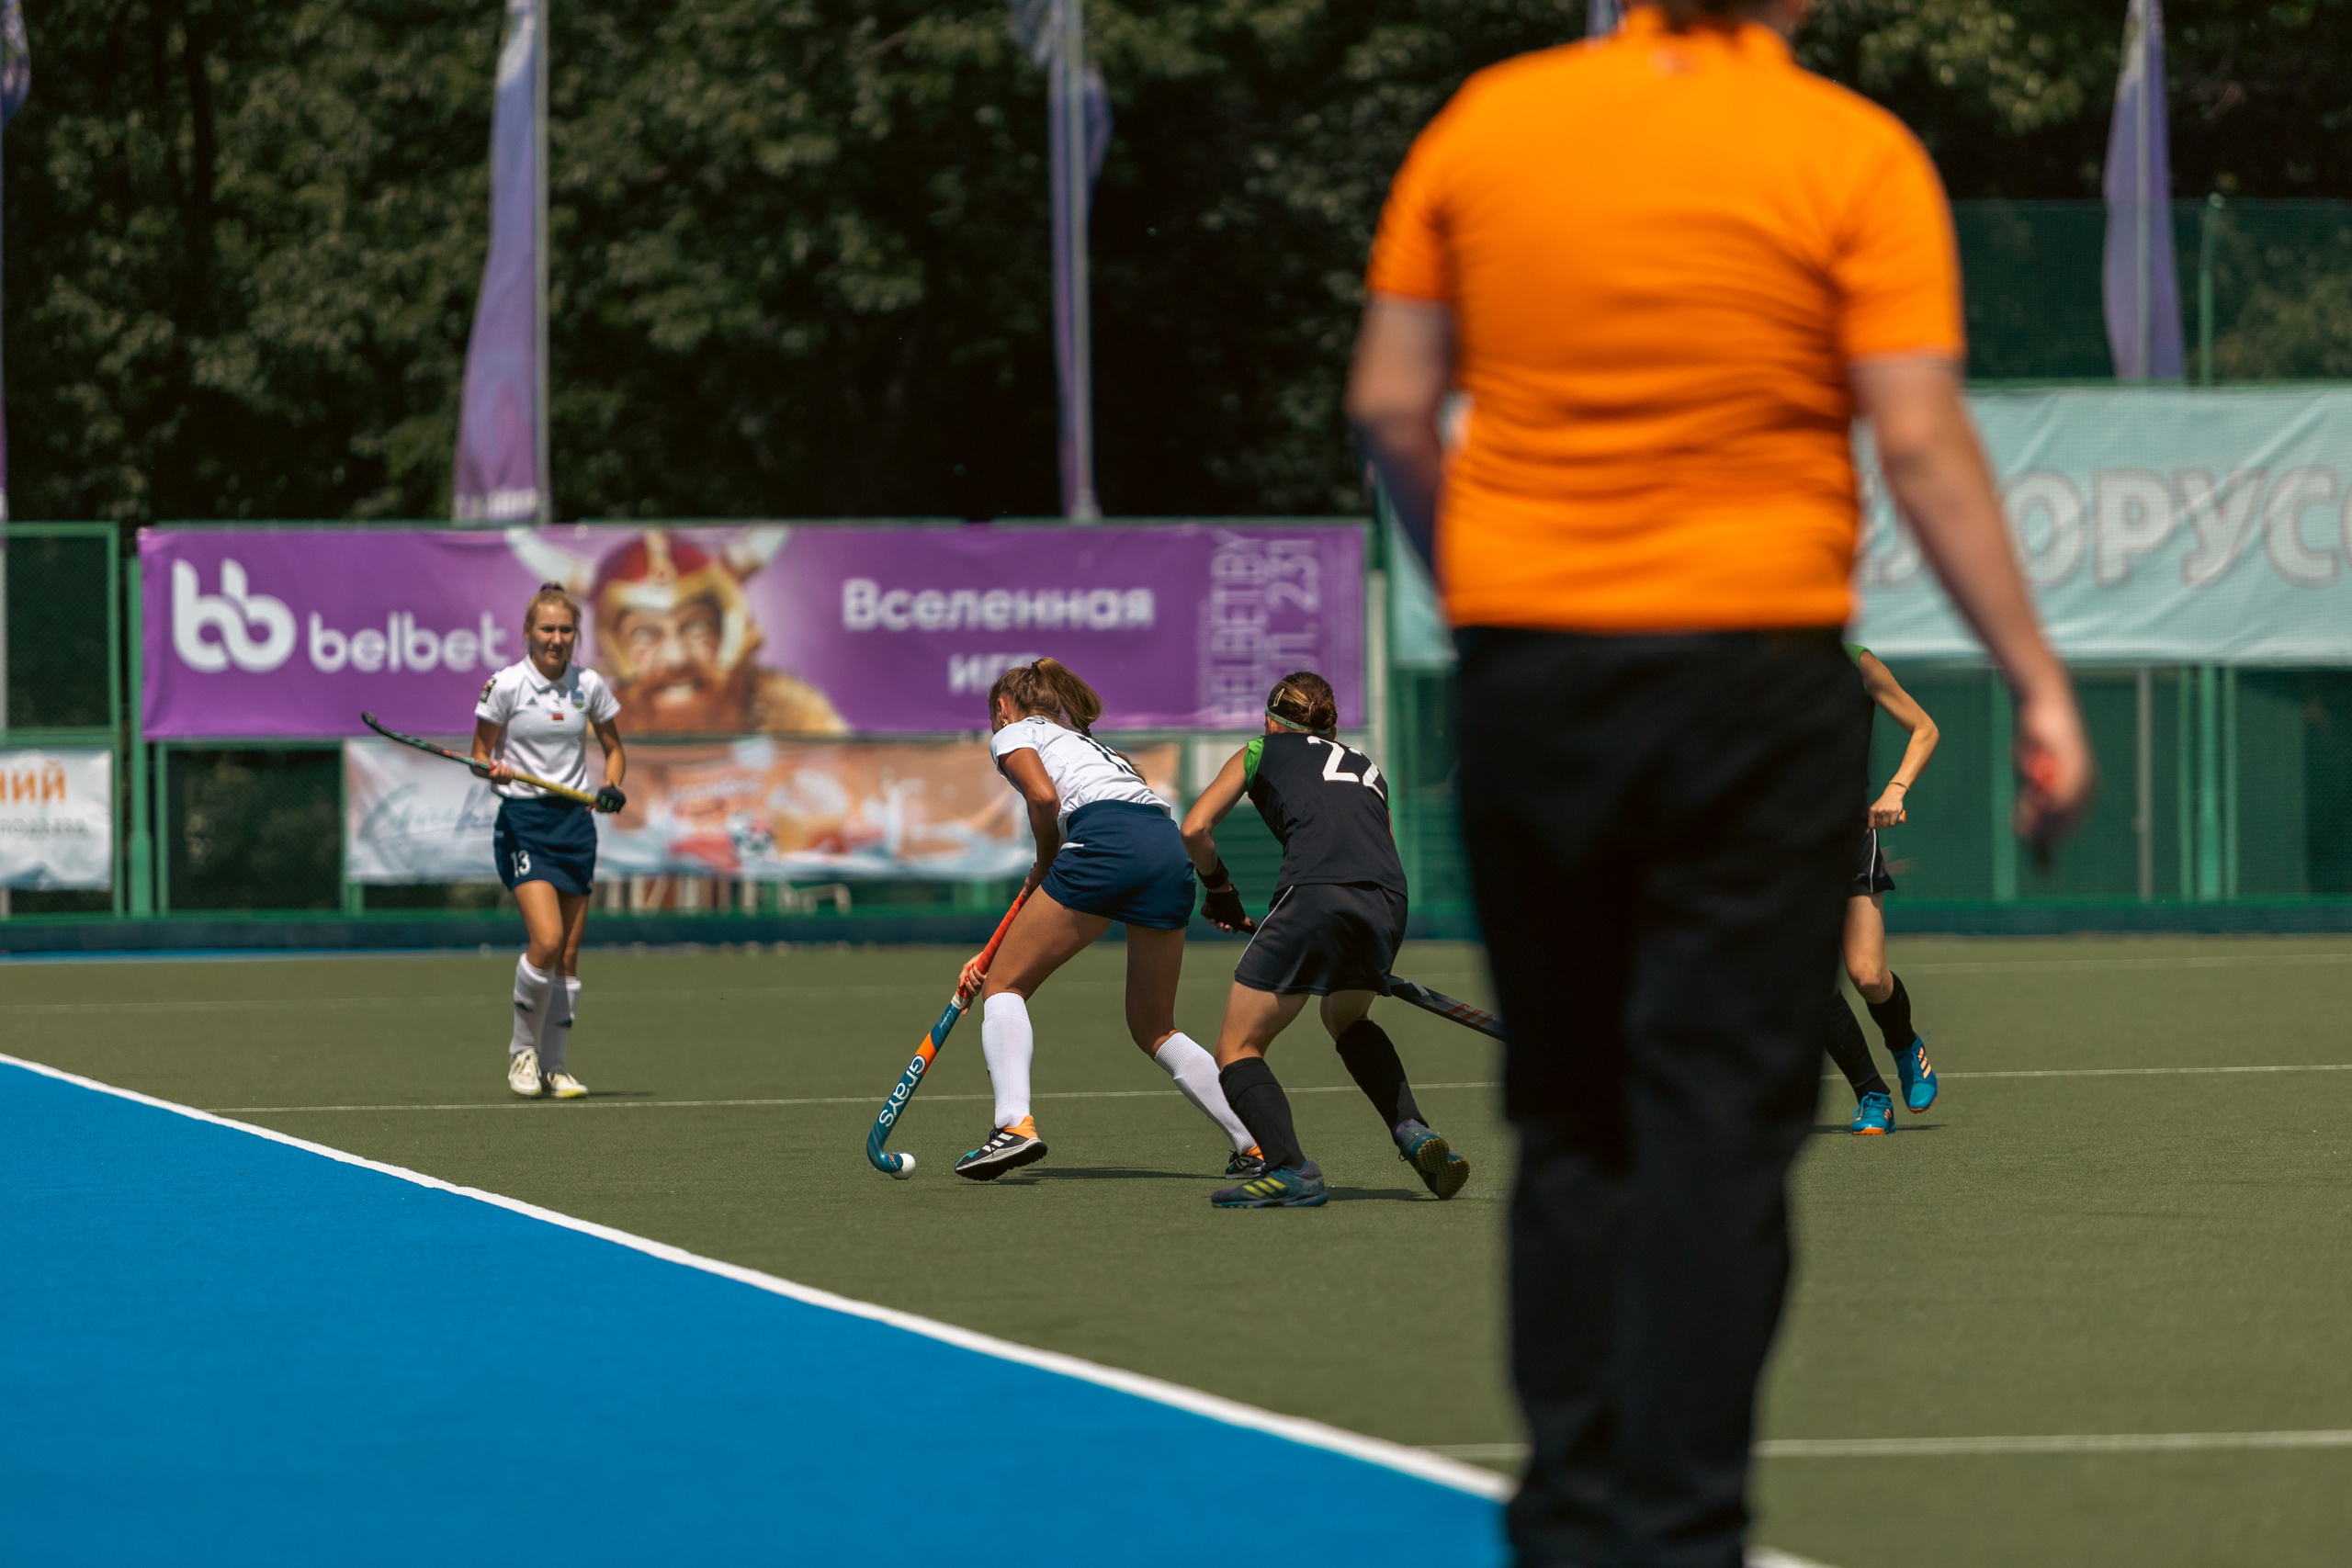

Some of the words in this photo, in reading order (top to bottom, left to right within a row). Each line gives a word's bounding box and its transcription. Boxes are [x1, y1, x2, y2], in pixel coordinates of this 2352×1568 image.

[842, 577, 1155, 632] Вселенная
[308, 609, 511, 674] belbet
[510, 849, 532, 878] 13
